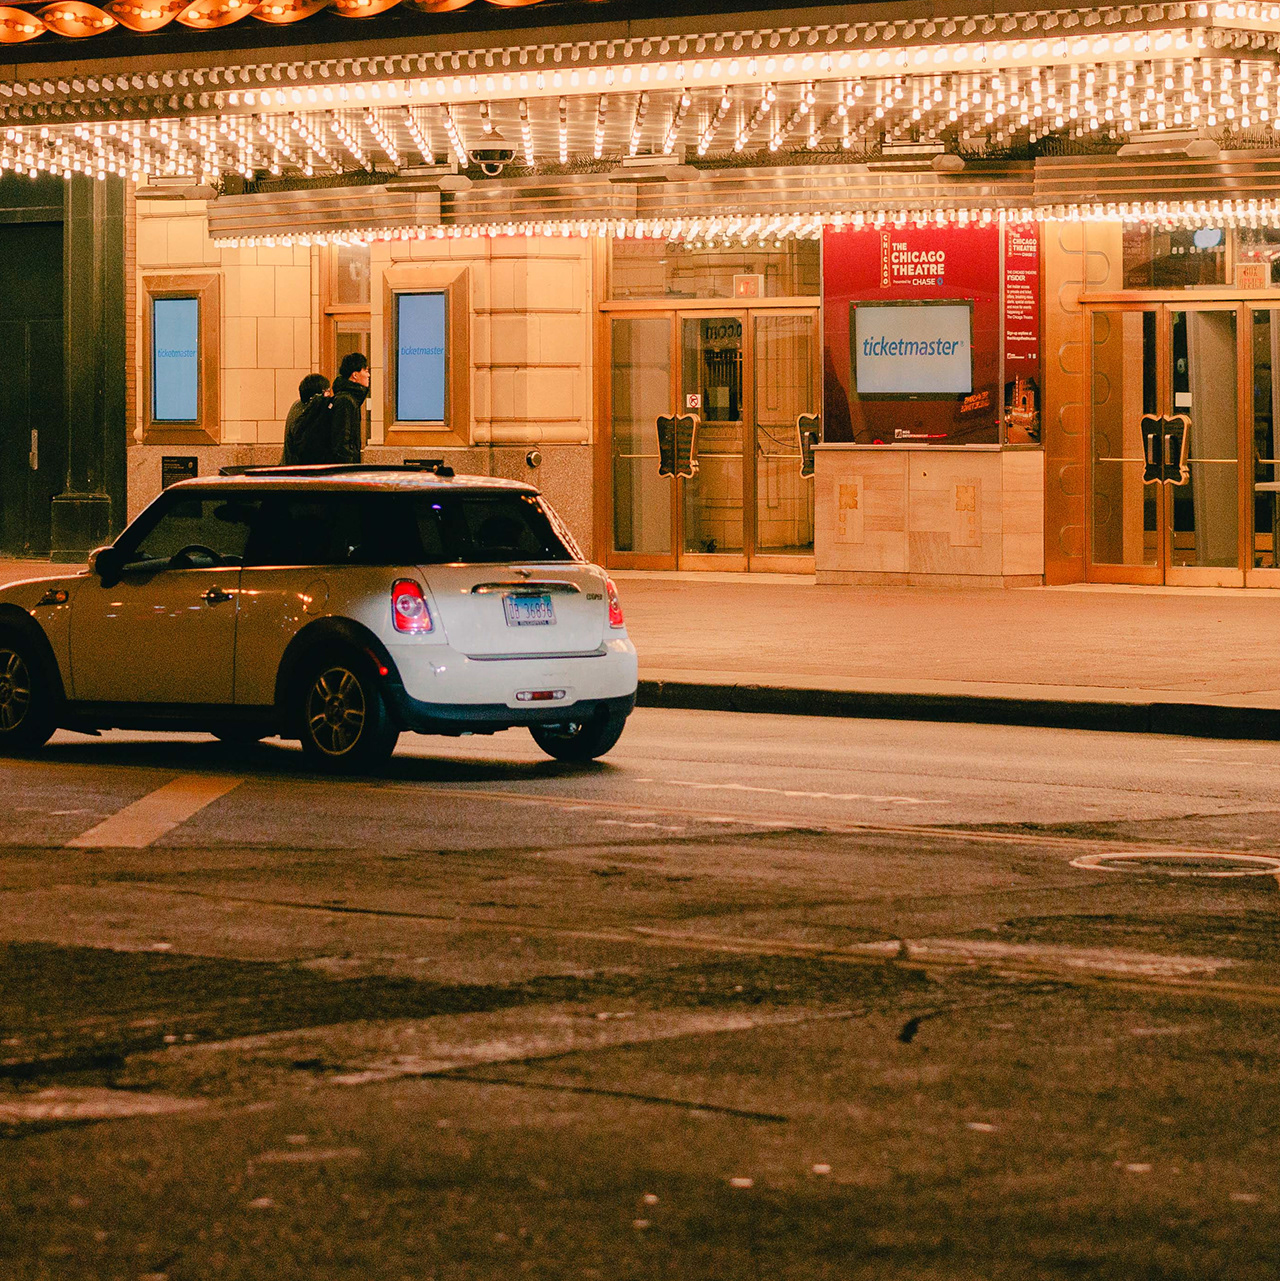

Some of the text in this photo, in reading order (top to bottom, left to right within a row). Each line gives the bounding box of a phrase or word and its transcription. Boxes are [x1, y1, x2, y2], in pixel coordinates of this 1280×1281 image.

[892, 242, 907, 251] THE
[891, 251, 946, 263] CHICAGO
[892, 263, 945, 276] THEATRE
[912, 278, 936, 286] CHASE
[157, 348, 197, 358] ticketmaster
[400, 345, 444, 356] ticketmaster
[524, 602, 553, 619] 36896
